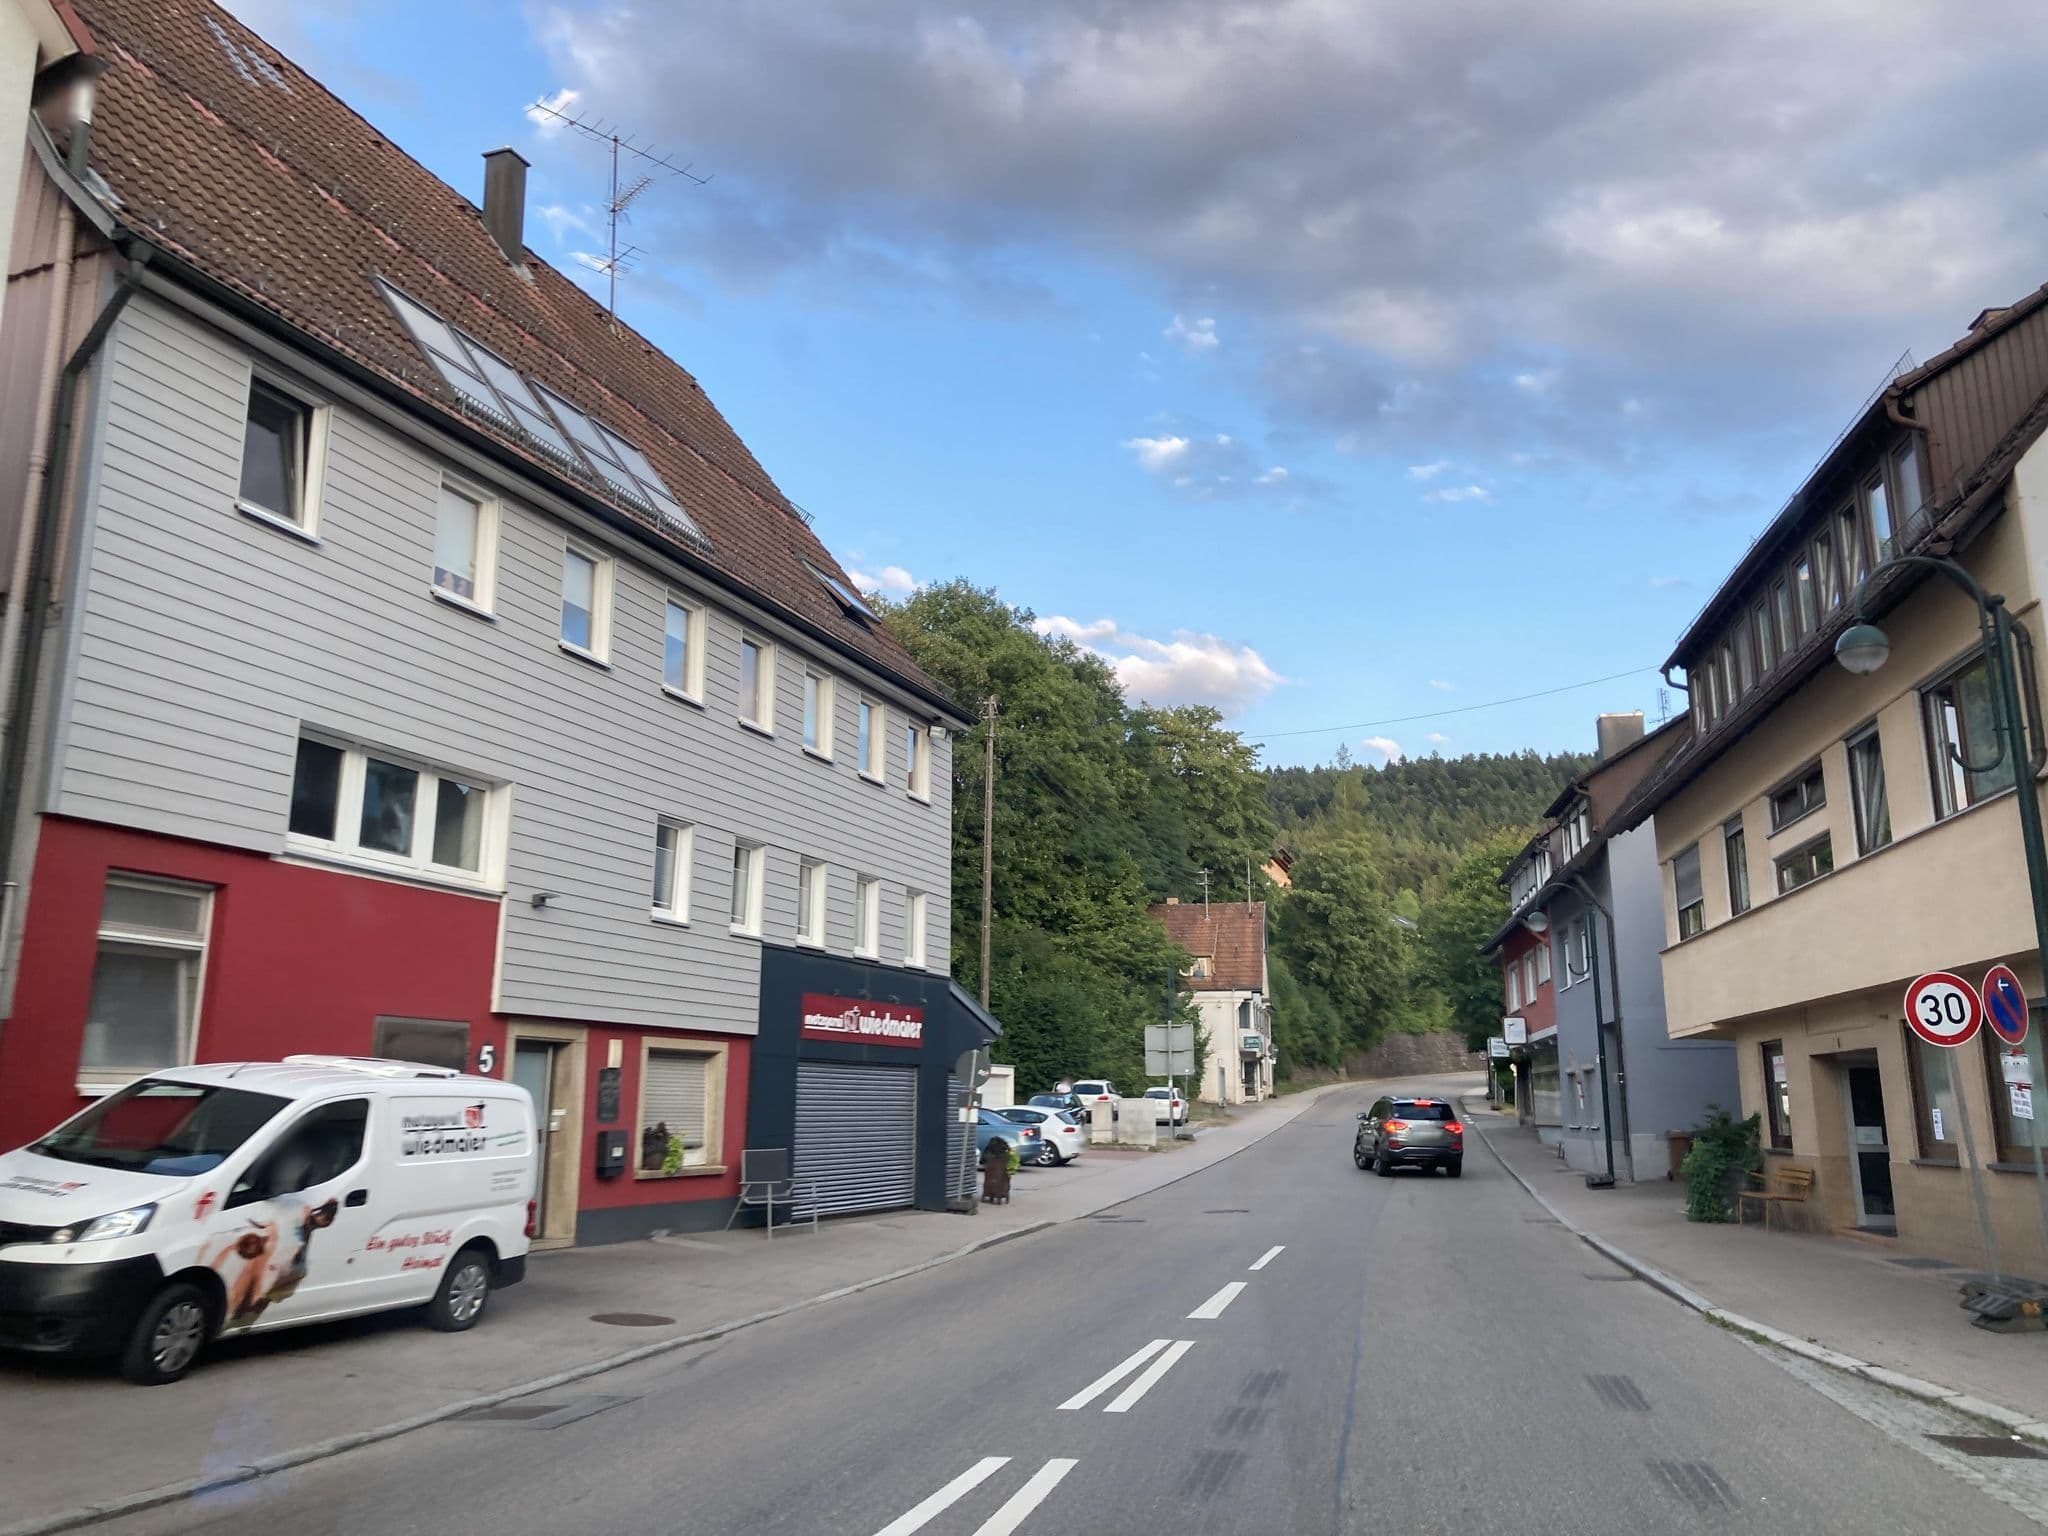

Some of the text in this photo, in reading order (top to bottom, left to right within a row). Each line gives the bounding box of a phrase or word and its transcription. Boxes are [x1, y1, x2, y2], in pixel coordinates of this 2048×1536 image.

[1920, 992, 1966, 1027] 30
[859, 1010, 923, 1039] wiedmaier
[478, 1044, 495, 1073] 5
[401, 1133, 487, 1156] wiedmaier
